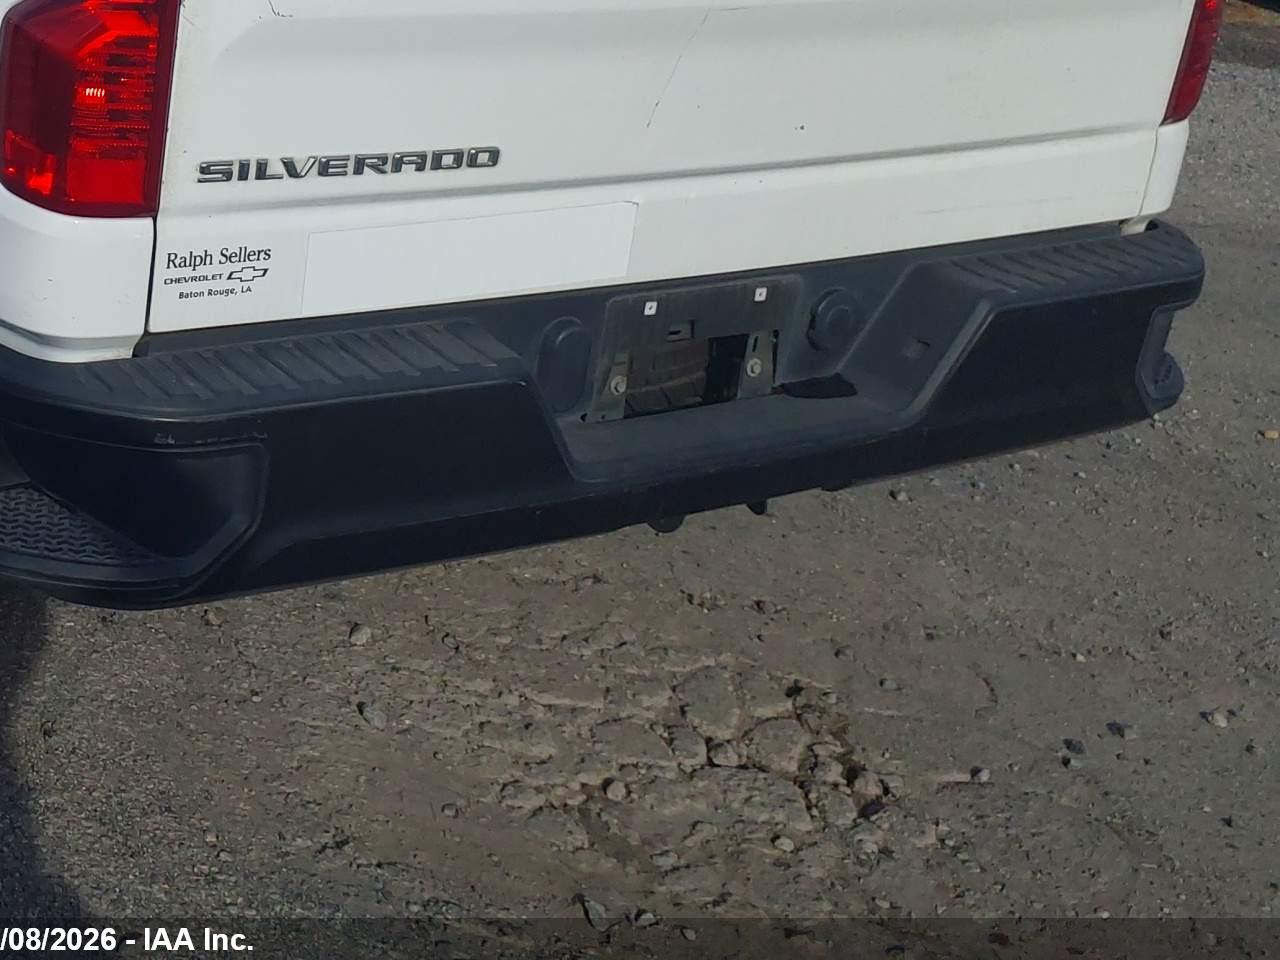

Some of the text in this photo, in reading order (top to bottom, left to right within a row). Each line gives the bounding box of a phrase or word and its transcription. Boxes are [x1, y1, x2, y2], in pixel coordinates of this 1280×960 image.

[197, 146, 501, 184] SILVERADO
[166, 246, 271, 271] Ralph Sellers
[164, 273, 223, 285] CHEVROLET
[178, 291, 205, 300] Baton
[207, 288, 238, 298] Rouge,
